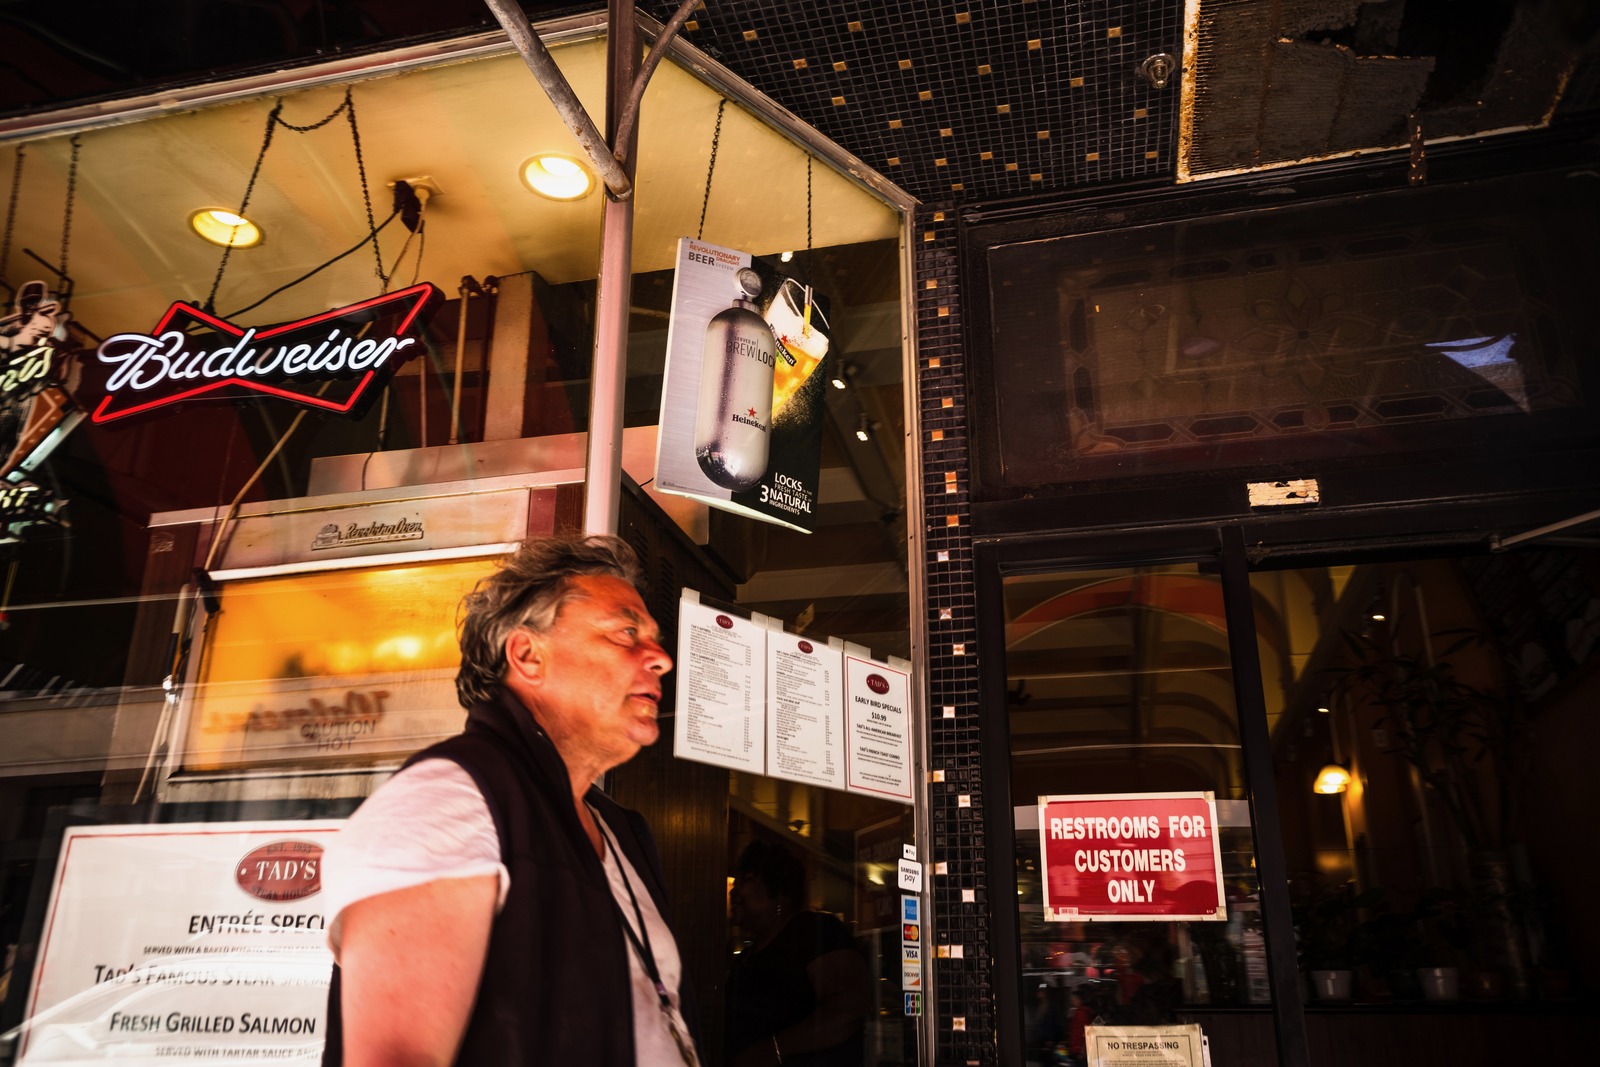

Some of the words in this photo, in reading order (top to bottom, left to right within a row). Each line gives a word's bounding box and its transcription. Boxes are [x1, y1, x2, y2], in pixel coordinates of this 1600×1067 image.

[688, 251, 715, 266] BEER
[689, 244, 741, 261] REVOLUTIONARY
[97, 328, 415, 391] Budweiser
[732, 413, 767, 432] Heineken
[774, 472, 803, 492] LOCKS
[774, 482, 791, 494] FRESH
[791, 489, 808, 501] TASTE
[759, 484, 769, 502] 3
[769, 487, 812, 514] NATURAL
[768, 499, 801, 516] INGREDIENTS
[855, 695, 870, 706] EARLY
[870, 699, 882, 709] BIRD
[881, 703, 902, 714] SPECIALS
[871, 711, 887, 722] $10.99
[300, 718, 376, 740] CAUTION
[317, 736, 356, 752] HOT
[1050, 816, 1160, 840] RESTROOMS
[1168, 815, 1206, 839] FOR
[1074, 848, 1186, 873] CUSTOMERS
[255, 859, 317, 882] TAD'S
[901, 866, 919, 876] SAMSUNG
[904, 874, 916, 884] pay
[1107, 879, 1155, 903] ONLY
[188, 909, 265, 934] ENTRÉE
[143, 946, 172, 955] SERVED
[173, 946, 195, 954] WITH
[905, 950, 919, 959] VISA
[109, 1011, 161, 1033] FRESH
[165, 1011, 235, 1033] GRILLED
[238, 1012, 317, 1035] SALMON
[154, 1046, 191, 1057] SERVED
[193, 1048, 219, 1057] WITH
[1107, 1042, 1120, 1050] NO
[1121, 1041, 1179, 1050] TRESPASSING
